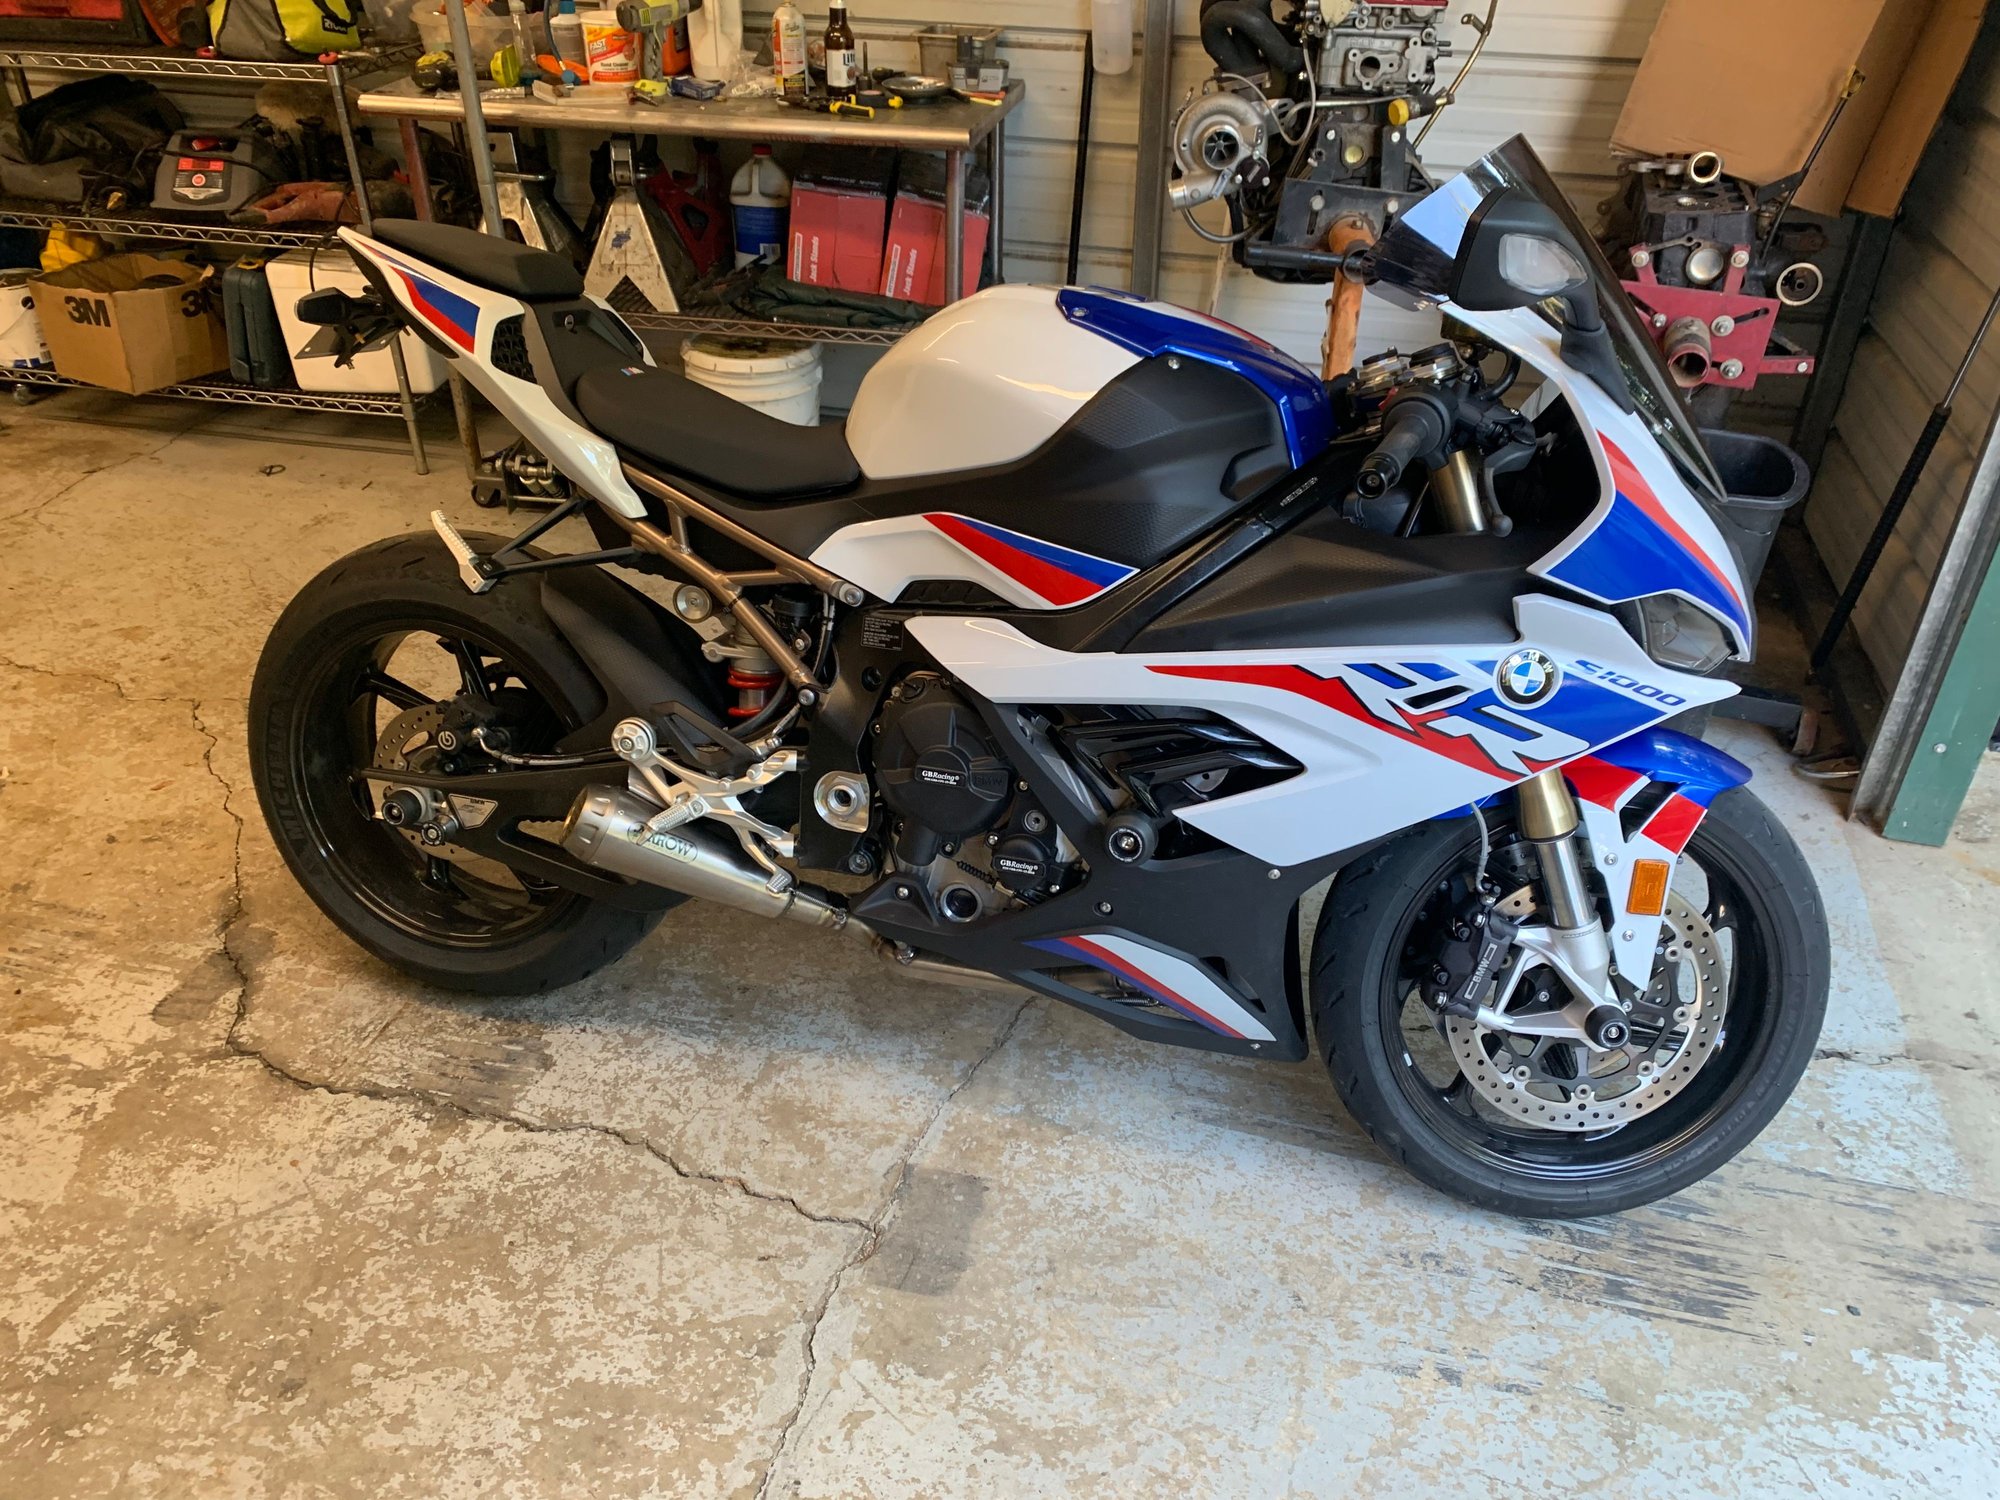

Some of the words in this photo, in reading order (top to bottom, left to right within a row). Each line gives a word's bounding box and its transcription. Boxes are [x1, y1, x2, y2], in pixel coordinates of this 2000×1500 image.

[64, 296, 111, 327] 3M
[1569, 659, 1687, 707] S1000
[1473, 957, 1490, 983] BMW
